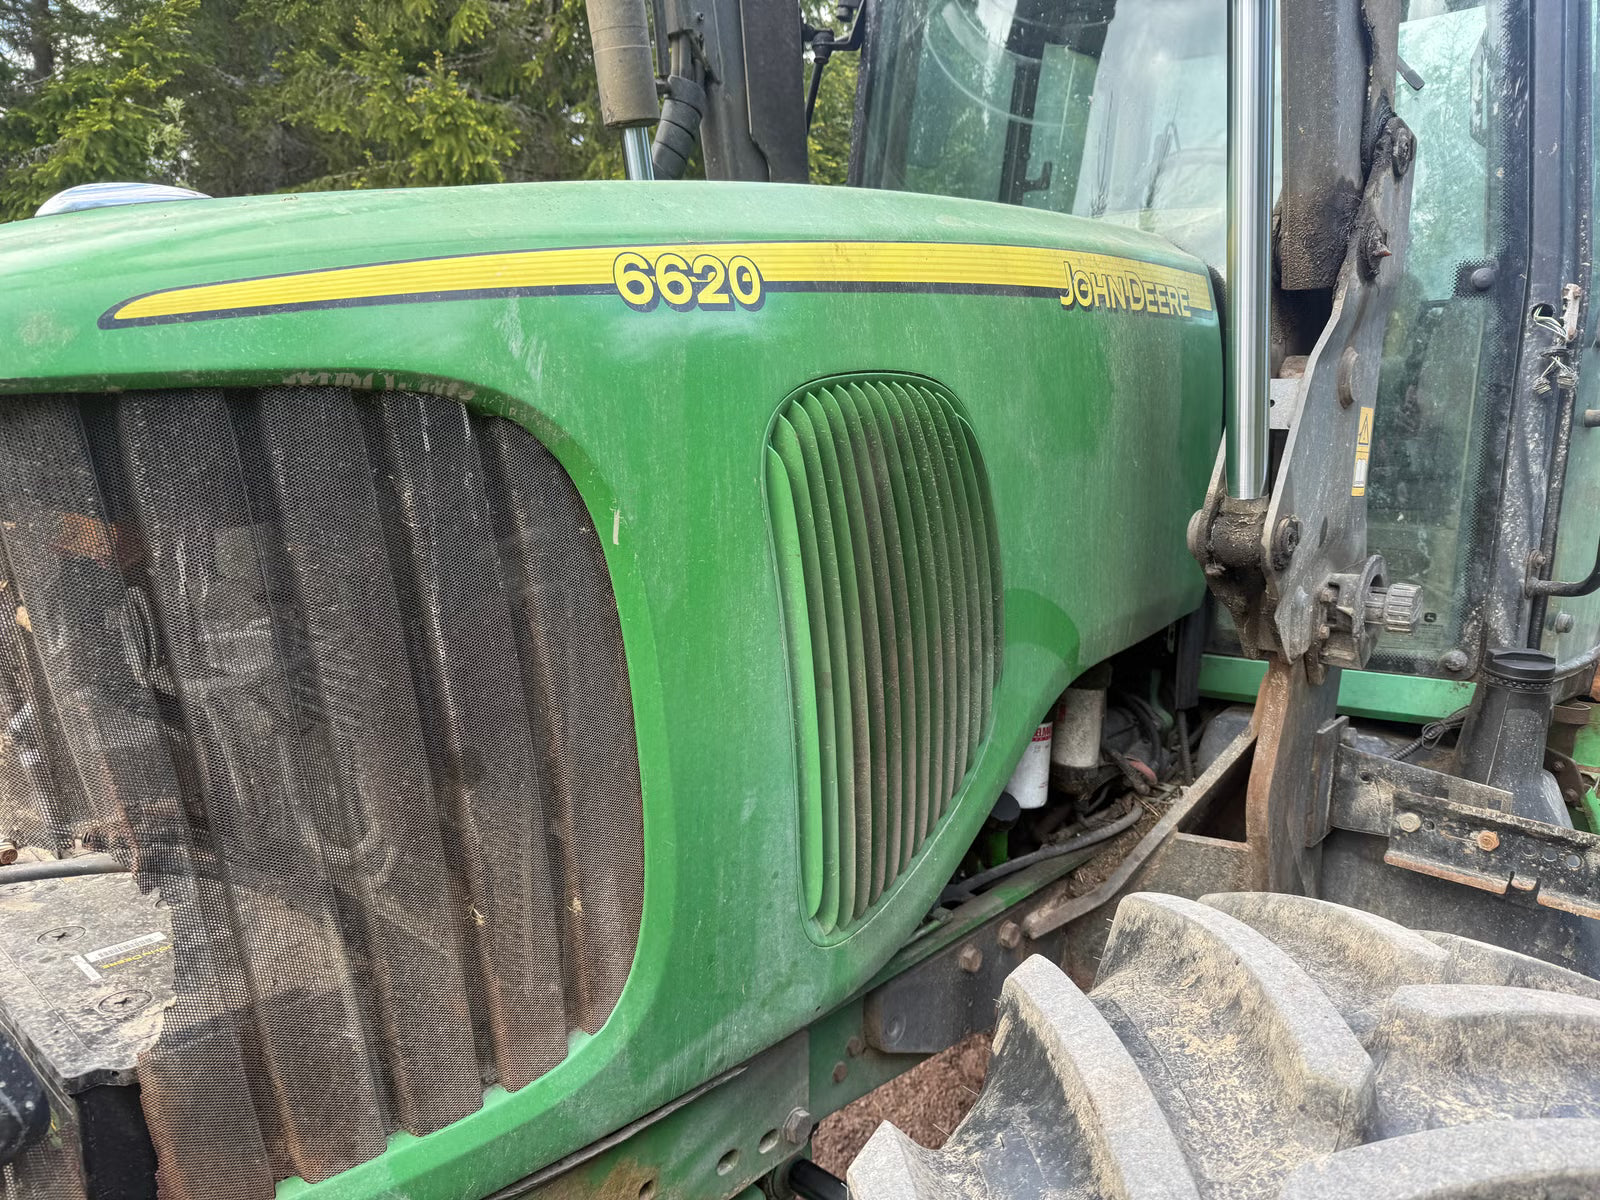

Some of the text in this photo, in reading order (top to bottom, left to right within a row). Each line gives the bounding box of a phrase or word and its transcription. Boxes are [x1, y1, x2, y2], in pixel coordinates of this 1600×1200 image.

[613, 251, 766, 313] 6620
[1060, 261, 1191, 317] JOHN DEERE
